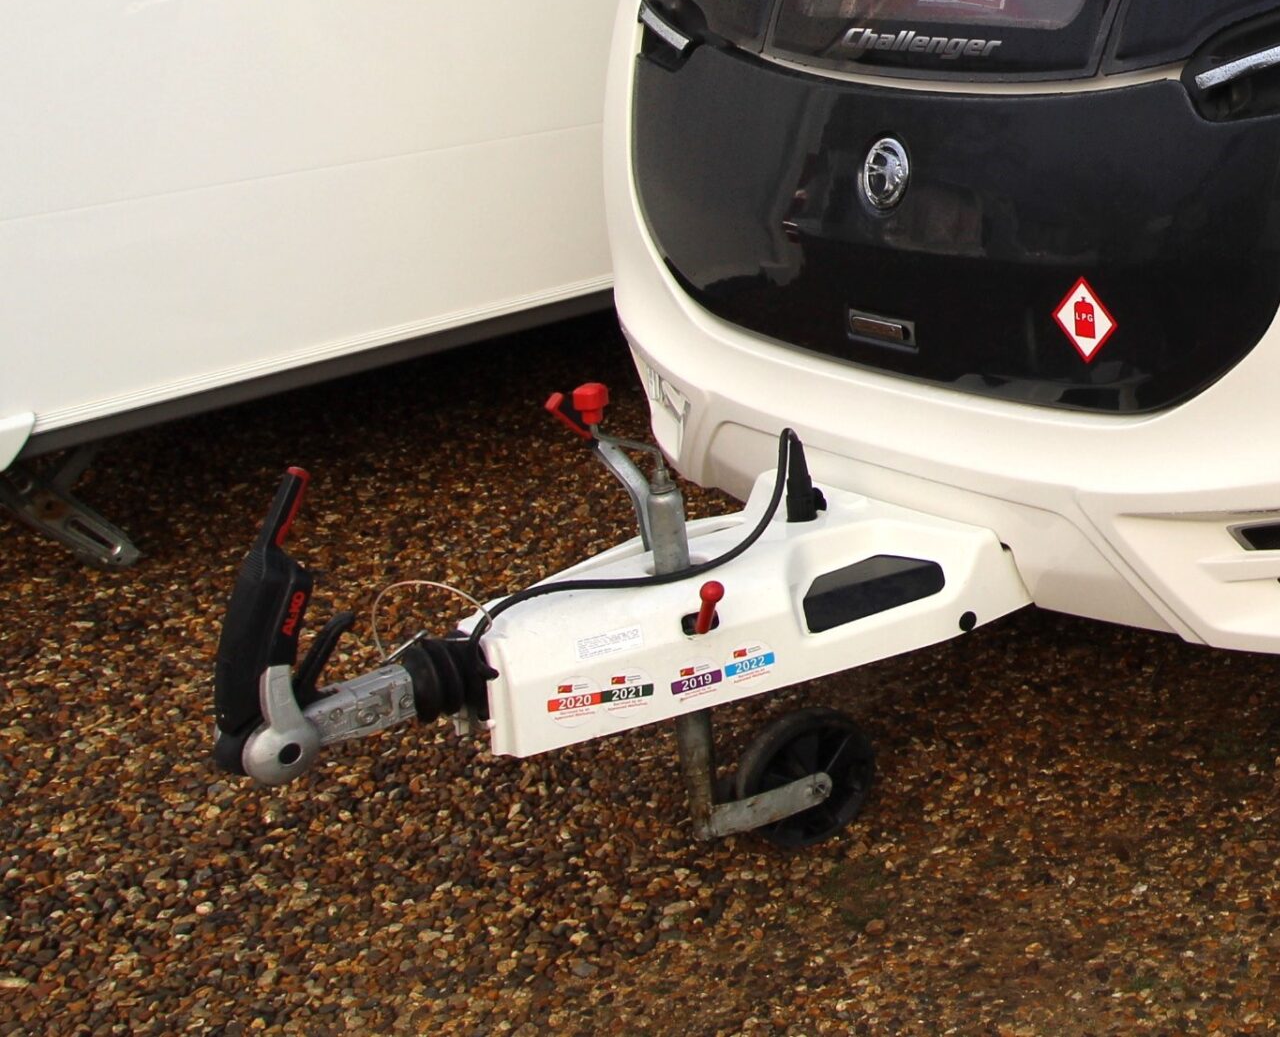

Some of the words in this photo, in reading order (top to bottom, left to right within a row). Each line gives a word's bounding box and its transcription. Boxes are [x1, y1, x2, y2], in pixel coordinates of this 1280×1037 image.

[842, 27, 1003, 60] Challenger
[735, 655, 766, 674] 2022
[681, 673, 712, 691] 2019
[558, 694, 592, 710] 2020
[611, 685, 644, 701] 2021
